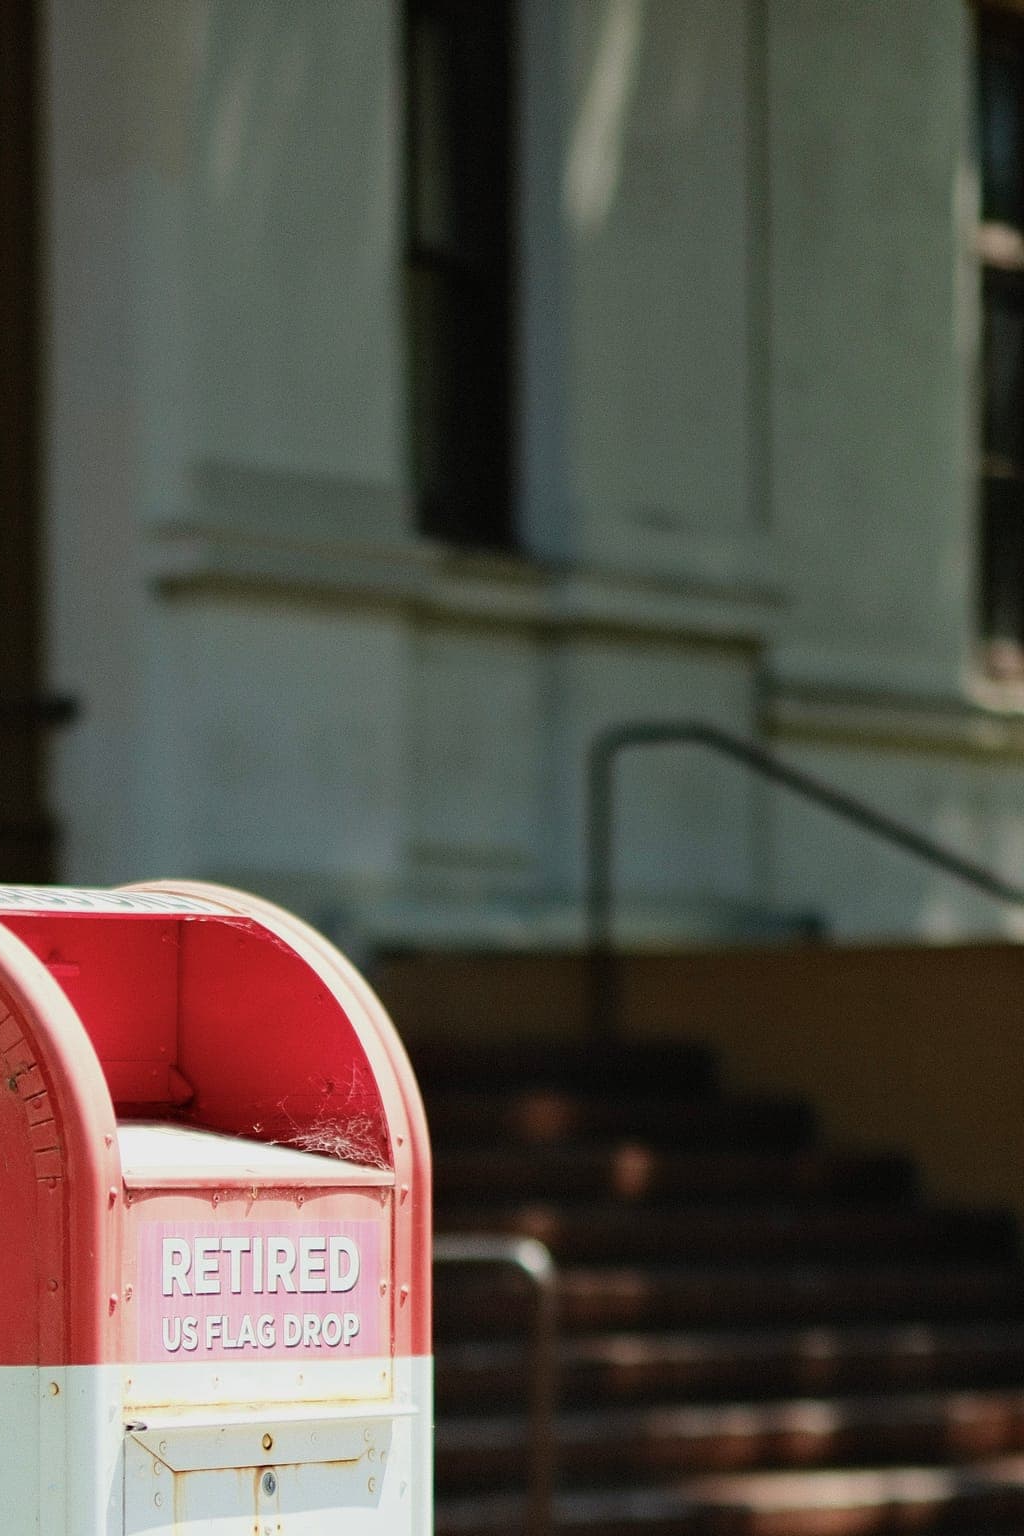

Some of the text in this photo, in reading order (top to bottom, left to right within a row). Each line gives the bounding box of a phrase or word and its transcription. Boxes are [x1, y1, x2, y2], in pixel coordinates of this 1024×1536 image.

[162, 1236, 361, 1296] RETIRED
[162, 1312, 361, 1352] US FLAG DROP
